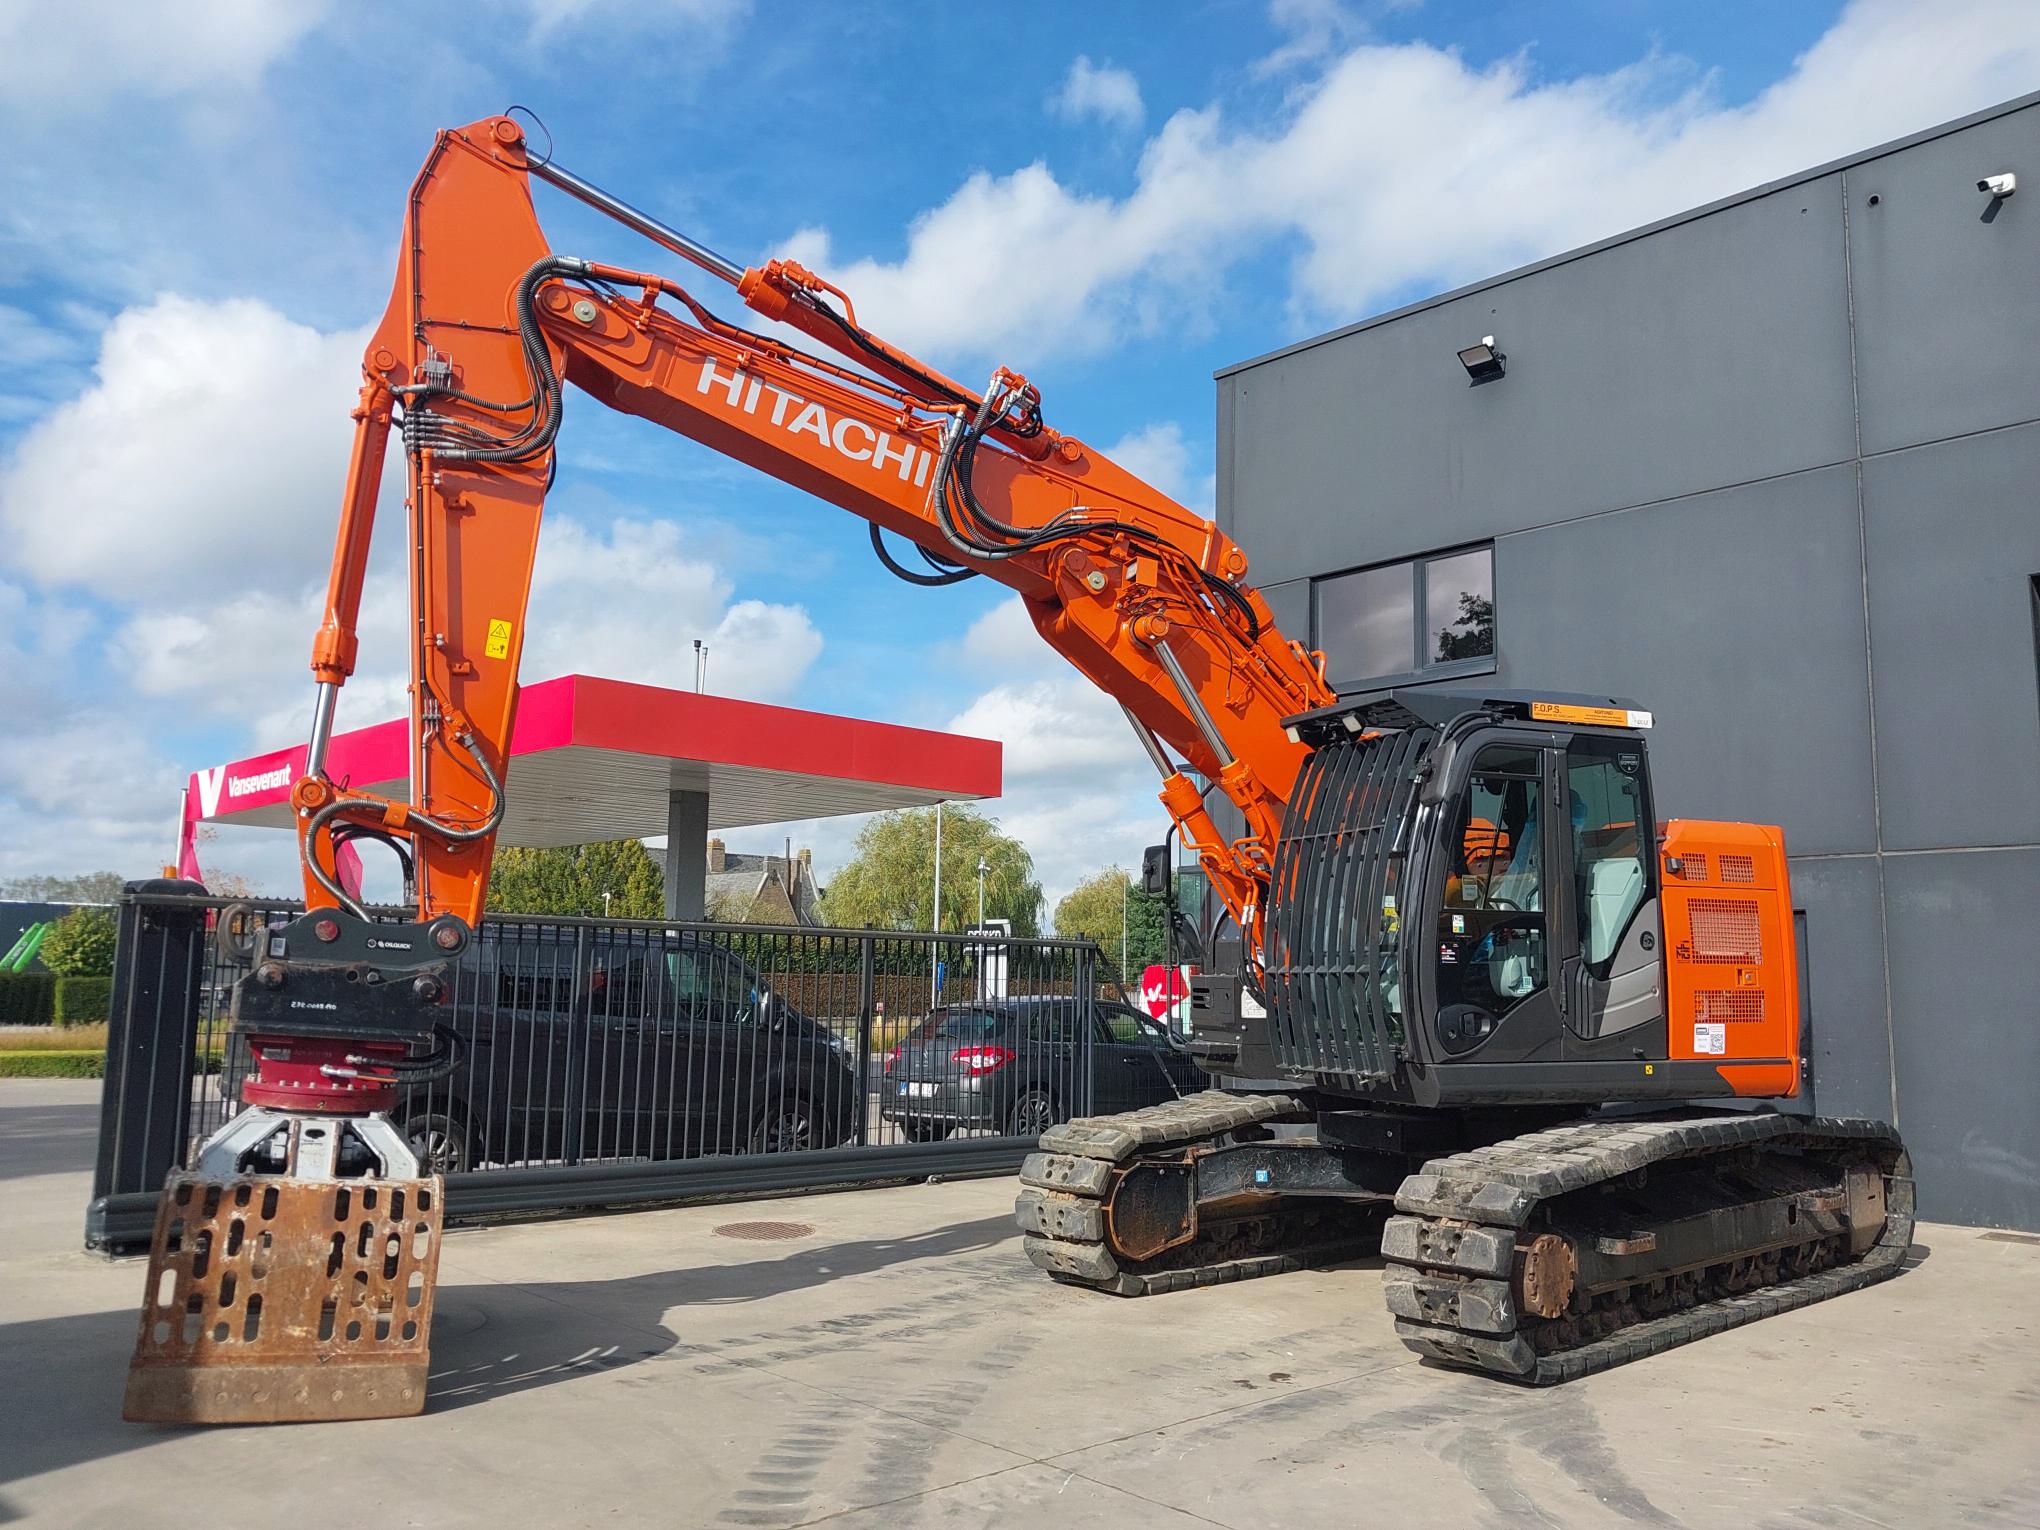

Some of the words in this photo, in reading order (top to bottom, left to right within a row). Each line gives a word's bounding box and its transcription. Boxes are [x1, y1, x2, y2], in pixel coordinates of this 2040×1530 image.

[696, 355, 931, 488] HITACHI
[1533, 703, 1561, 714] F.O.P.S.
[228, 763, 292, 797] Vansevenant
